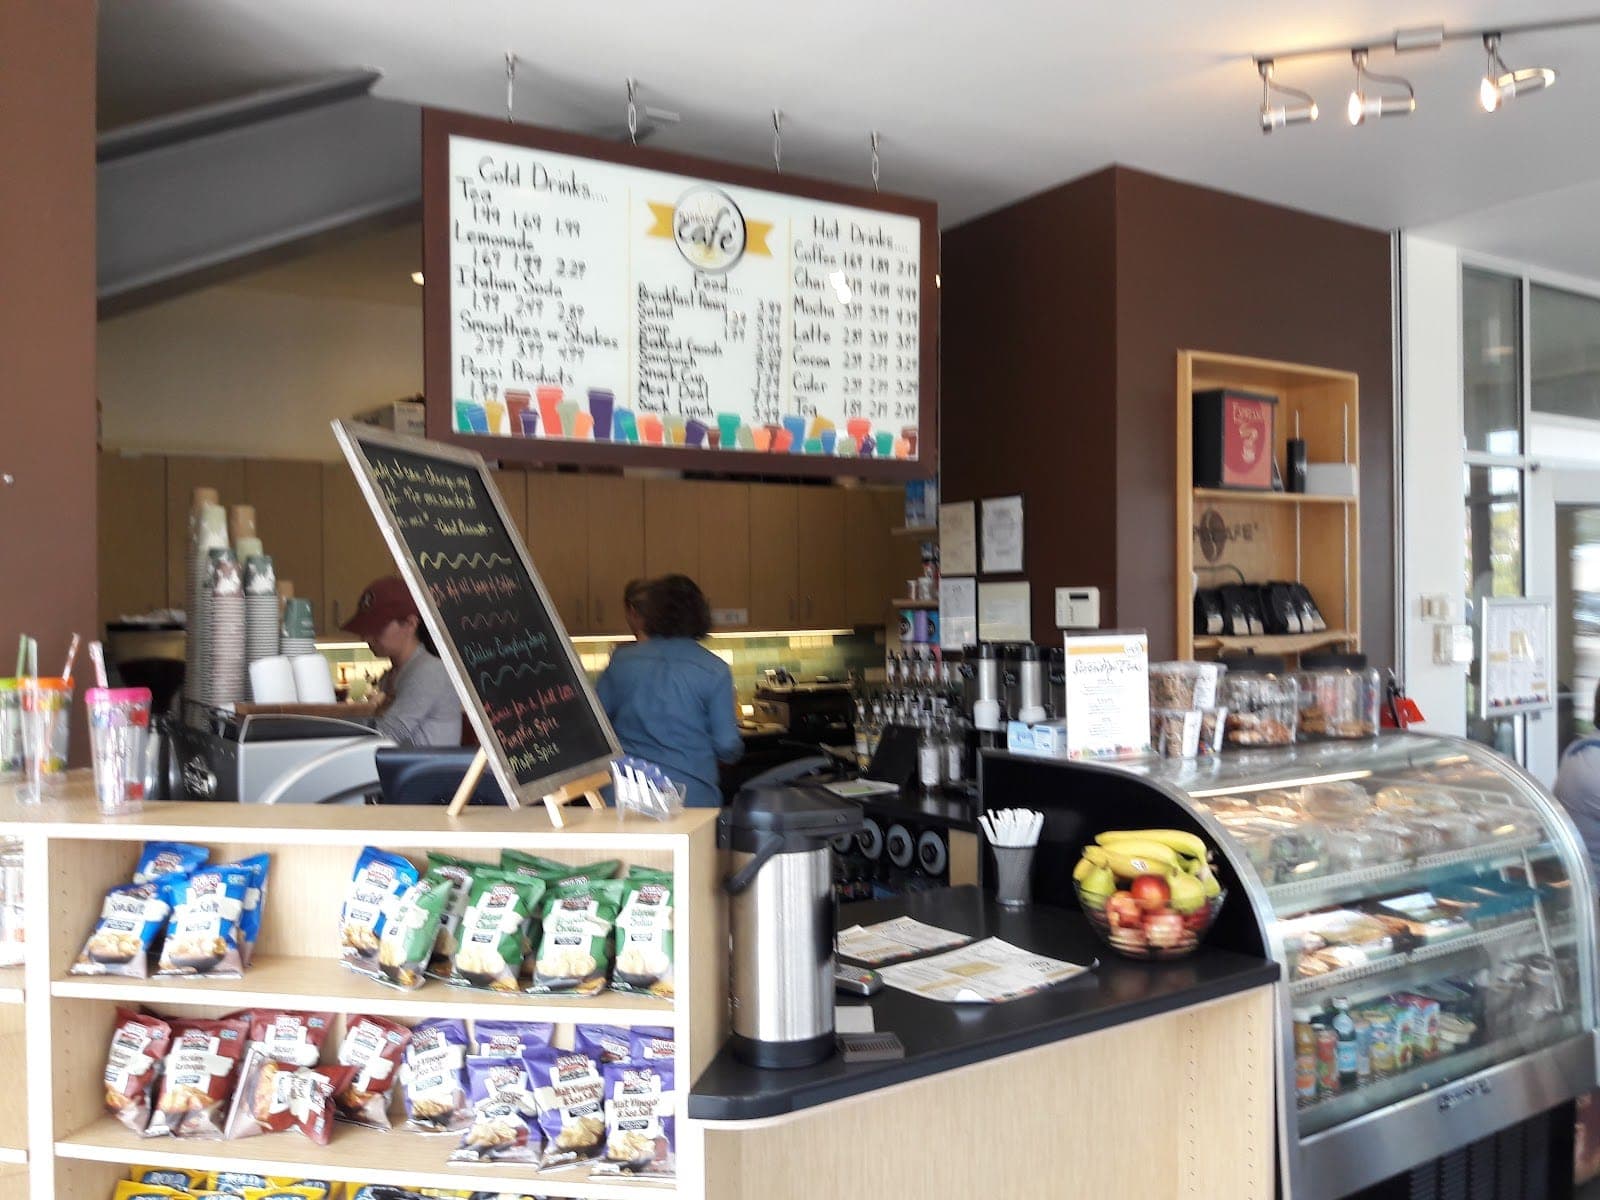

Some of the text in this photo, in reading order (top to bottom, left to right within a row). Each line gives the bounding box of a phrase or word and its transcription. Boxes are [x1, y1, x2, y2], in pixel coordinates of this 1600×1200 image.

[479, 156, 520, 187] Cold
[456, 176, 492, 202] Tea
[456, 219, 535, 251] Lemonade
[813, 215, 839, 241] Hot
[794, 240, 837, 264] Coffee
[456, 264, 562, 298] Italian Soda
[794, 267, 826, 290] Chai
[638, 281, 694, 308] Breakfast
[794, 295, 835, 319] Mocha
[460, 310, 540, 340] Smoothies
[562, 321, 619, 350] Shakes
[793, 320, 831, 344] Latte
[793, 344, 831, 368] Cocoa
[461, 355, 574, 387] Pepsi Products
[793, 369, 828, 393] Cider
[793, 395, 818, 418] Tea
[497, 717, 560, 753] Pumpkin Spice
[533, 742, 561, 765] Spice
